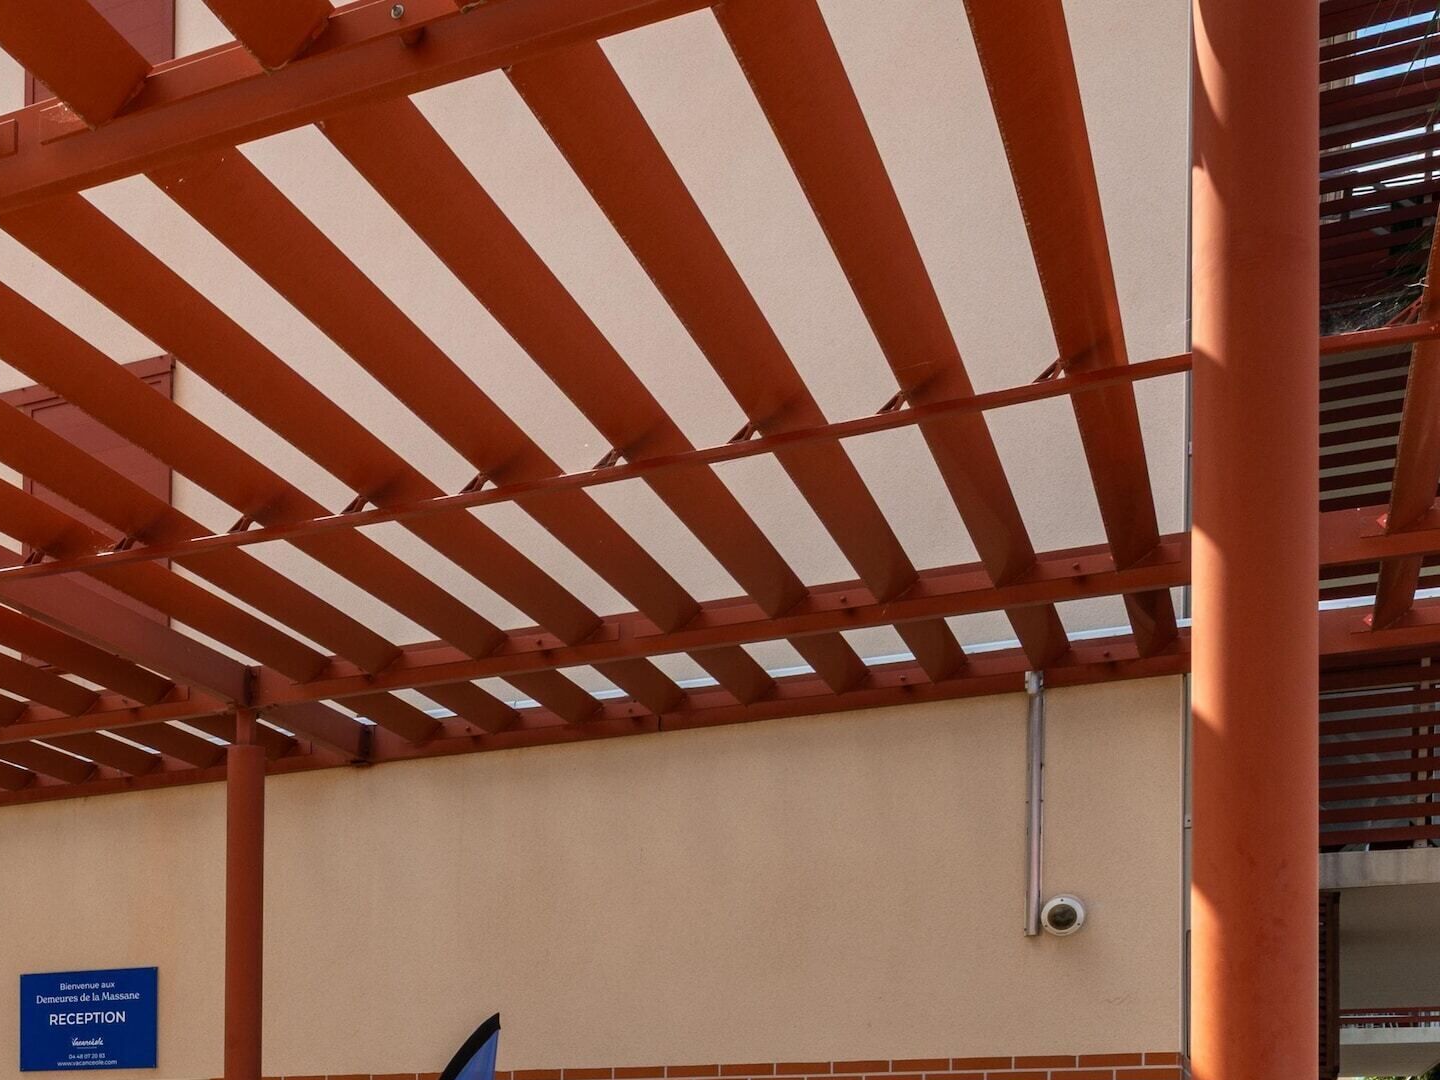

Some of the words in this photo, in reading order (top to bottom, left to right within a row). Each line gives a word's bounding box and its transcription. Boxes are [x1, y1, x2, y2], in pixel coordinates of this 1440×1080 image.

[60, 982, 100, 991] Bienvenue
[36, 994, 78, 1004] Demeures
[80, 994, 90, 1002] de
[92, 993, 100, 1001] la
[101, 992, 140, 1001] Massane
[49, 1011, 126, 1025] RECEPTION
